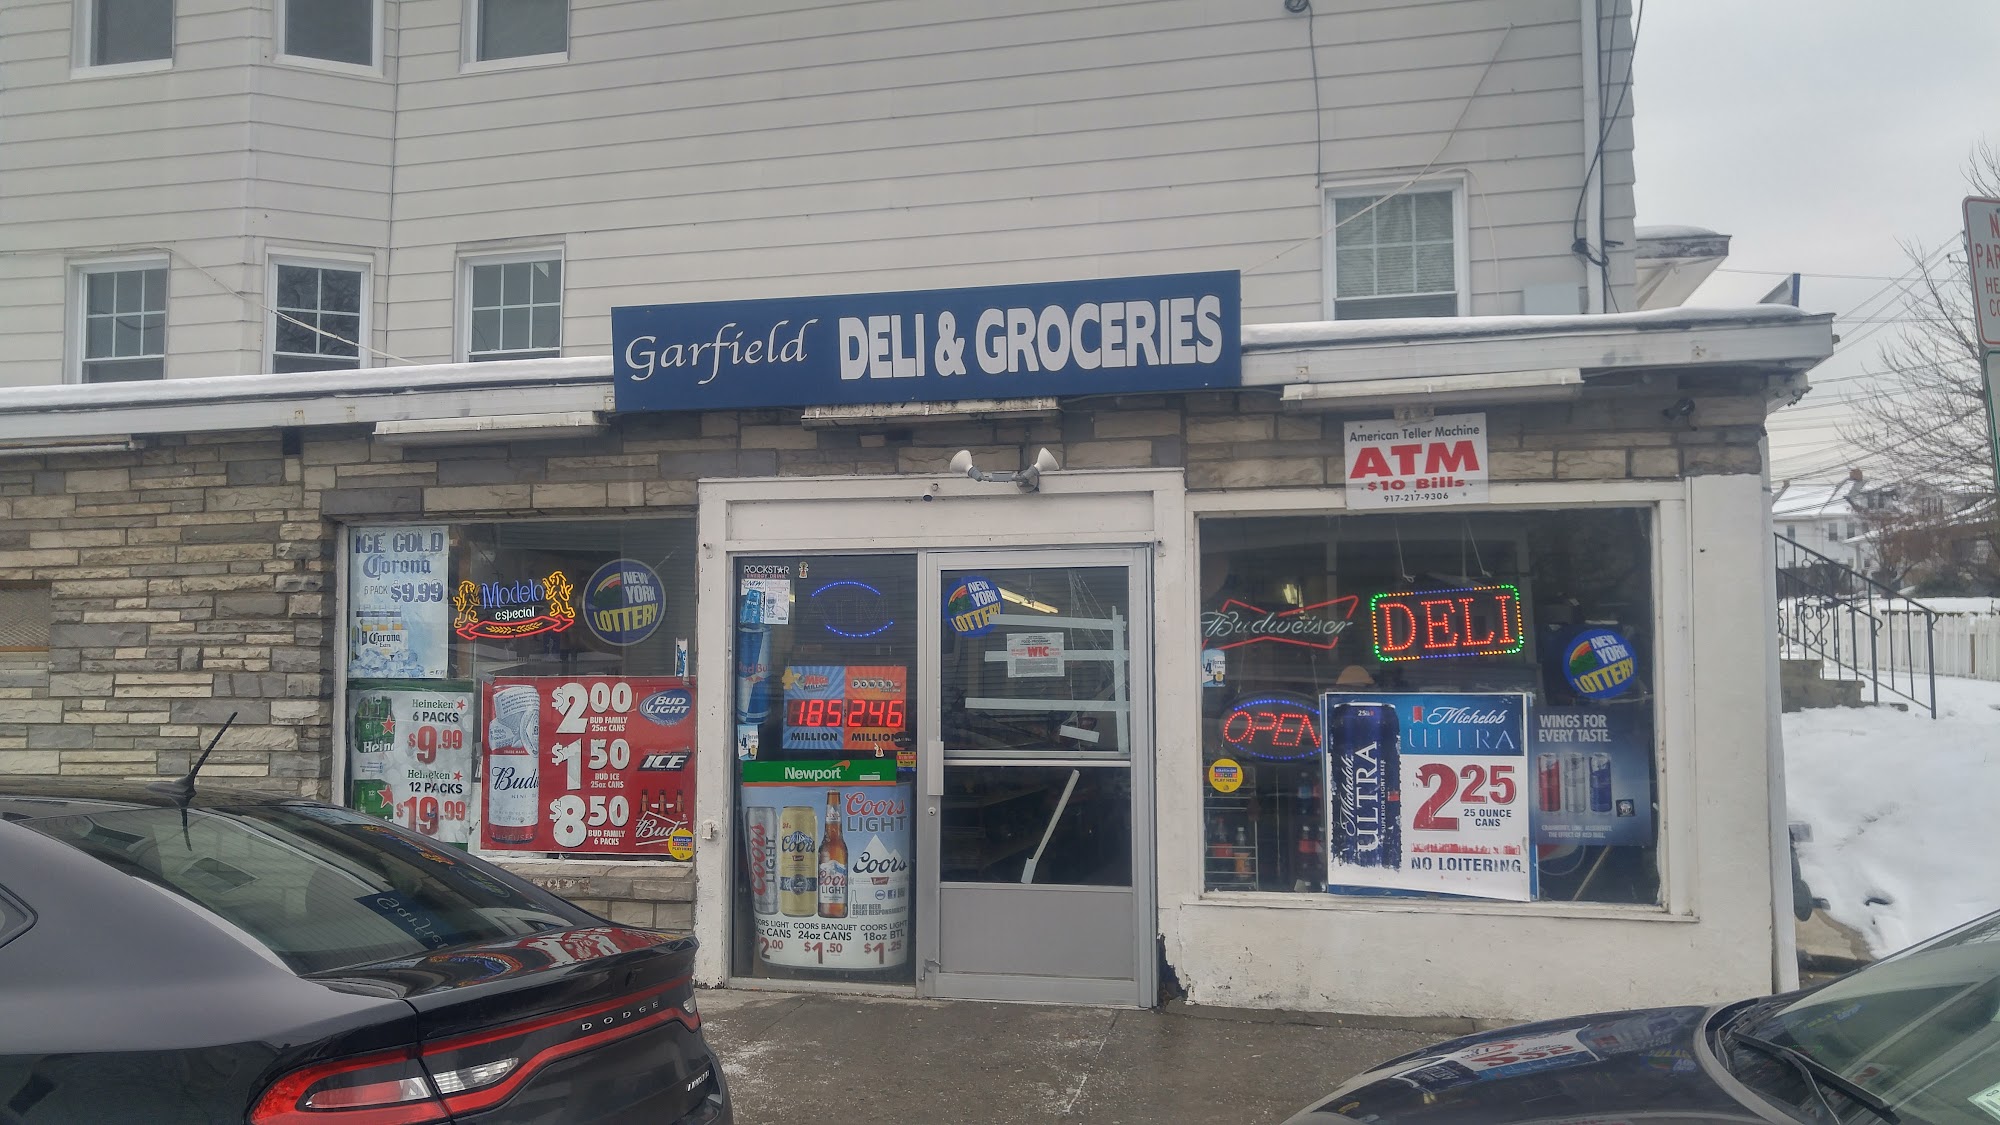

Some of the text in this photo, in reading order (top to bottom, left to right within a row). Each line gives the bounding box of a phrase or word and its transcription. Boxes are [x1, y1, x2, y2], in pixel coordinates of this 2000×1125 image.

[624, 294, 1223, 386] Garfield DELI & GROCERIES
[1350, 424, 1480, 443] American Teller Machine
[1349, 440, 1480, 479] ATM
[1367, 476, 1465, 492] $10 Bills
[1384, 493, 1449, 503] 917-217-9306
[355, 529, 444, 554] ICE COLD
[362, 554, 432, 581] Corona
[623, 571, 649, 585] NEW
[370, 585, 388, 595] PACK
[391, 579, 444, 603] $9.99
[481, 579, 545, 609] Modelo
[967, 580, 989, 593] NEW
[625, 585, 656, 604] YORK
[971, 590, 998, 607] YORK
[495, 606, 535, 622] especial
[593, 602, 659, 633] LOTTERY
[951, 602, 1001, 632] LOTTERY
[1200, 612, 1353, 637] Budweiser
[1379, 595, 1515, 651] DELI
[368, 632, 402, 645] Corona
[1591, 634, 1617, 649] NEW
[1027, 646, 1049, 657] WIC
[1596, 643, 1628, 665] YORK
[1573, 656, 1634, 694] LOTTERY
[852, 680, 893, 689] POWER
[412, 699, 454, 709] Heineken
[654, 696, 686, 705] BUD
[412, 711, 459, 723] 6 PACKS
[647, 705, 690, 714] LIGHT
[798, 699, 843, 727] 185
[847, 699, 904, 727] 246
[1427, 706, 1508, 725] Michelob
[605, 716, 628, 725] FAMILY
[608, 724, 625, 732] CANS
[1540, 714, 1607, 728] WINGS FOR
[790, 732, 838, 742] MILLION
[1224, 711, 1322, 748] OPEN
[1538, 729, 1611, 742] EVERY TASTE.
[408, 725, 463, 765] $9.99
[642, 755, 688, 769] ICE
[595, 773, 620, 781] BUD ICE
[785, 767, 842, 782] Newport
[409, 782, 463, 794] 12 PACKS
[590, 781, 624, 789] 25oz CANS
[1339, 754, 1357, 837] Michelob
[1355, 741, 1379, 852] ULTRA
[845, 792, 905, 816] Coors
[396, 796, 466, 836] $19.99
[1463, 809, 1512, 818] 25 OUNCE
[847, 816, 907, 833] LIGHT
[1475, 818, 1501, 827] CANS
[603, 830, 626, 838] FAMILY
[600, 838, 620, 846] PACKS
[750, 822, 767, 896] Coors
[765, 837, 776, 883] LIGHT
[853, 851, 908, 874] Coors
[1411, 857, 1432, 870] NO
[821, 886, 845, 895] LIGHT
[771, 920, 789, 929] LIGHT
[793, 922, 858, 931] COORS BANQUET
[889, 919, 908, 930] LIGHT
[766, 928, 791, 939] CANS
[797, 931, 852, 941] 24oz CANS
[863, 929, 905, 941] 18oz BTL
[804, 942, 843, 965] $1.50
[581, 1001, 659, 1031] DODGE
